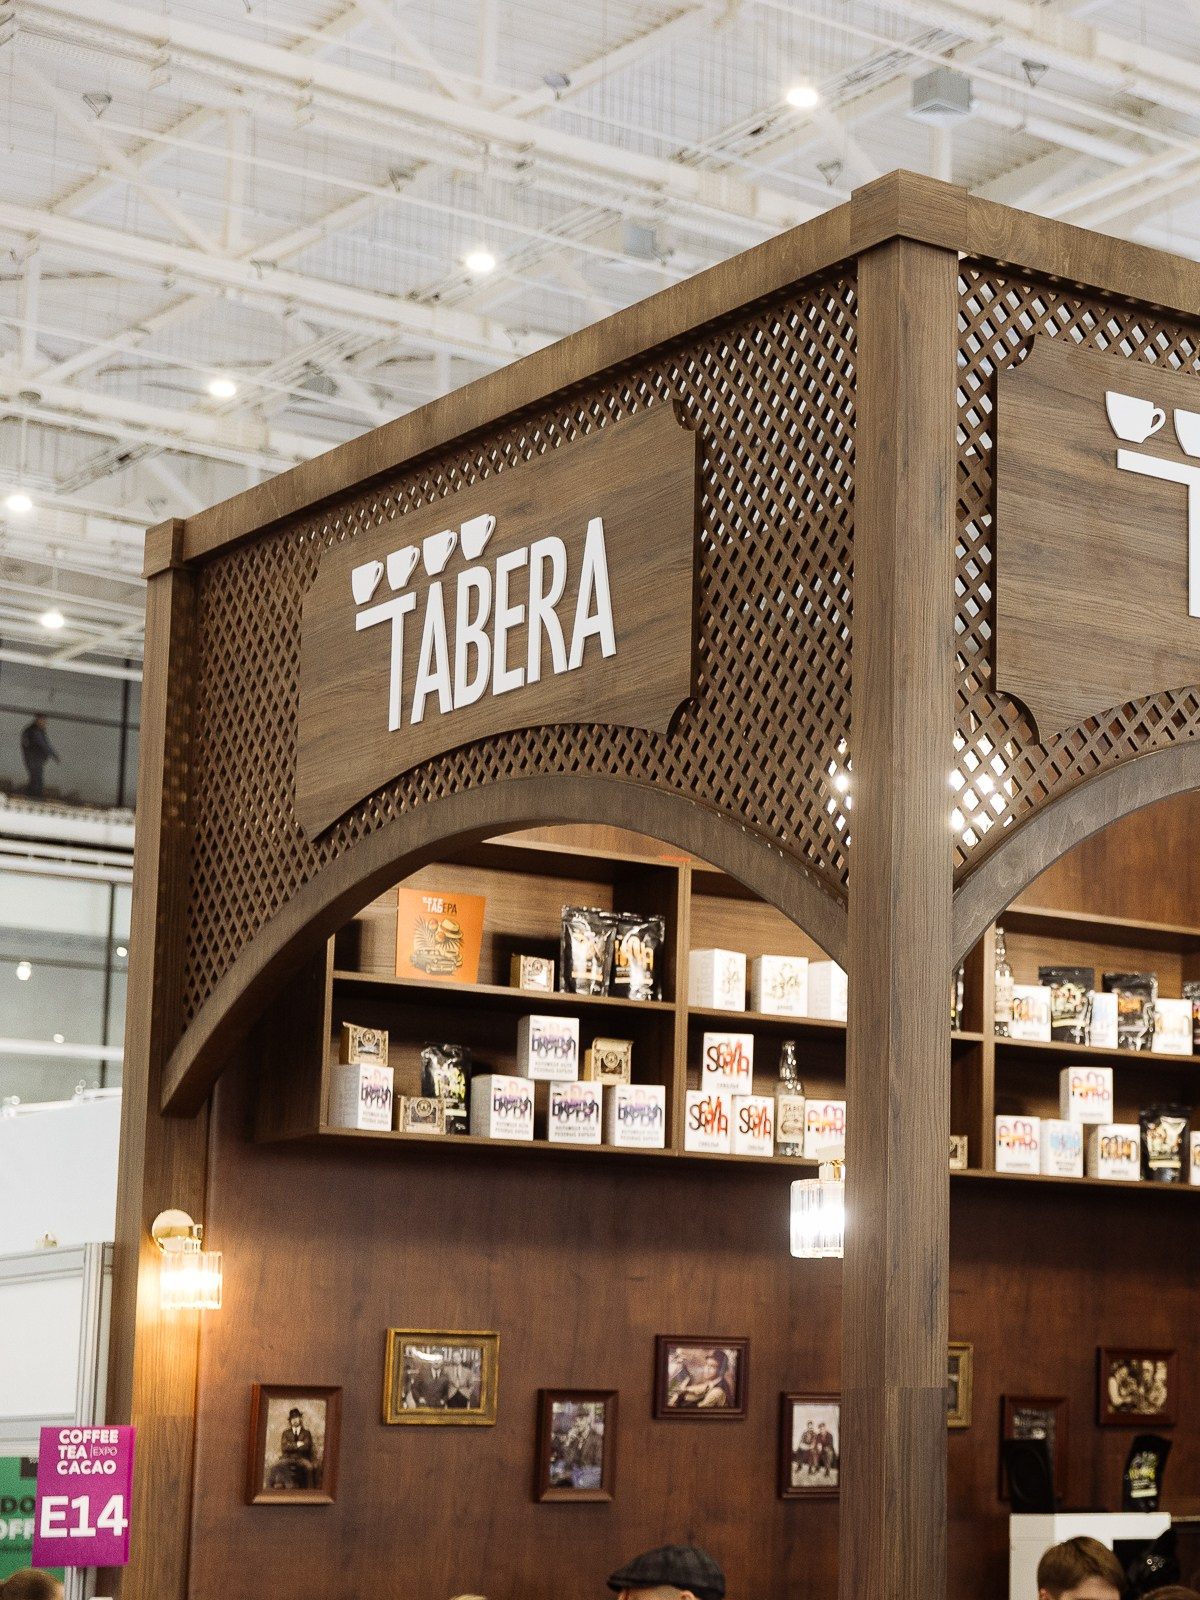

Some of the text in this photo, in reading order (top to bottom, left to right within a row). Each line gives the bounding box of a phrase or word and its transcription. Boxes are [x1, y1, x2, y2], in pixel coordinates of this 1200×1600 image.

[355, 516, 617, 732] TABERA
[58, 1429, 119, 1444] COFFEE
[57, 1445, 88, 1460] TEA
[56, 1460, 117, 1475] CACAO
[40, 1494, 129, 1539] E14
